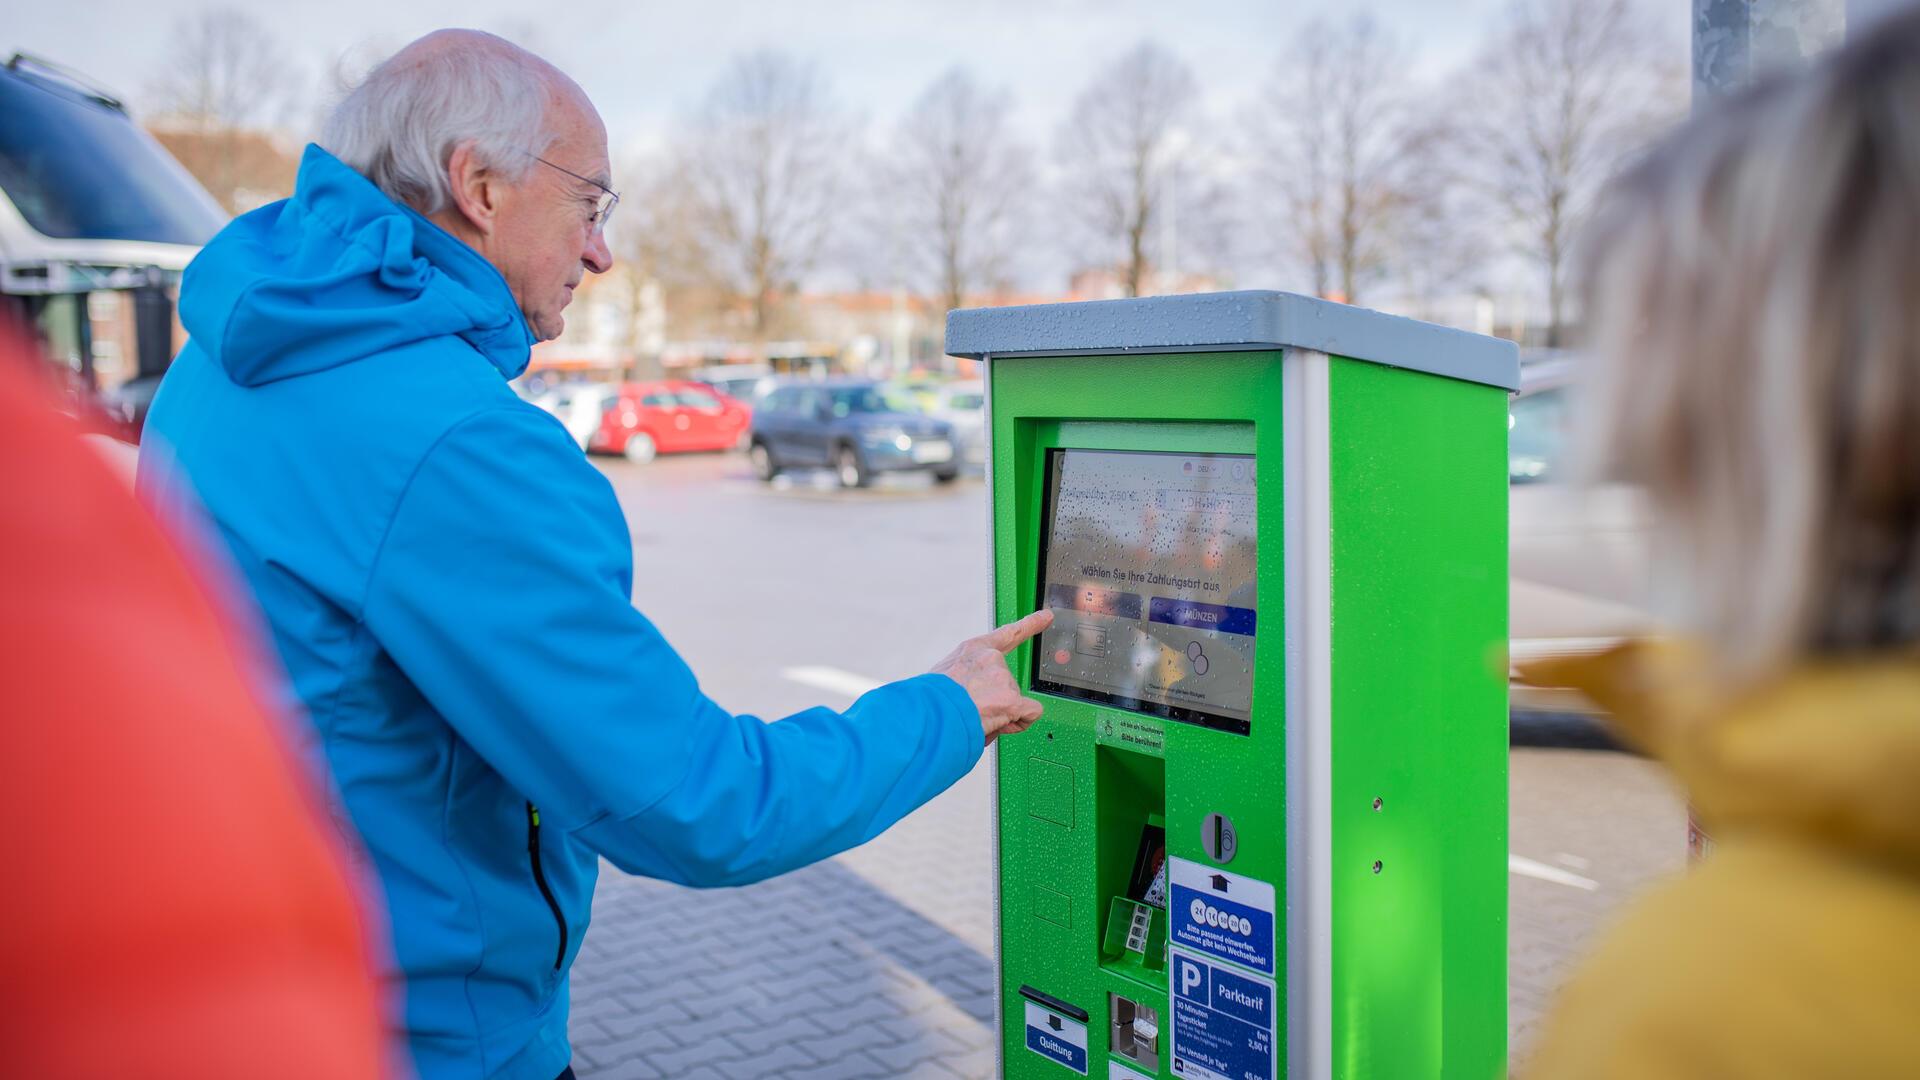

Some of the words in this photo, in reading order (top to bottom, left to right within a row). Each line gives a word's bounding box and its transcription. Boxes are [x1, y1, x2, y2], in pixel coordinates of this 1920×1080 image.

[1081, 564, 1111, 578] Wählen
[1113, 568, 1126, 580] Sie
[1128, 569, 1145, 583] Ihre
[1147, 572, 1201, 590] Zahlungsart
[1184, 608, 1218, 623] MÜNZEN
[1121, 732, 1134, 743] Bitte
[1135, 734, 1162, 749] berühren!
[1186, 923, 1200, 934] Bitte
[1200, 929, 1224, 943] passend
[1177, 929, 1202, 944] Automat
[1202, 938, 1214, 949] gibt
[1214, 940, 1227, 952] kein
[1227, 944, 1267, 966] Wechselgeld!
[1182, 960, 1201, 996] P
[1219, 983, 1264, 1012] Parktarif
[1176, 1000, 1184, 1010] 30
[1184, 1002, 1209, 1019] Minuten
[1177, 1011, 1207, 1030] Tagesticket
[1248, 1038, 1263, 1052] 2,50
[1257, 1030, 1269, 1042] frei
[1040, 1035, 1073, 1061] Quittung
[1177, 1043, 1187, 1053] Bei
[1187, 1047, 1208, 1062] Verstoß
[1208, 1056, 1215, 1066] je
